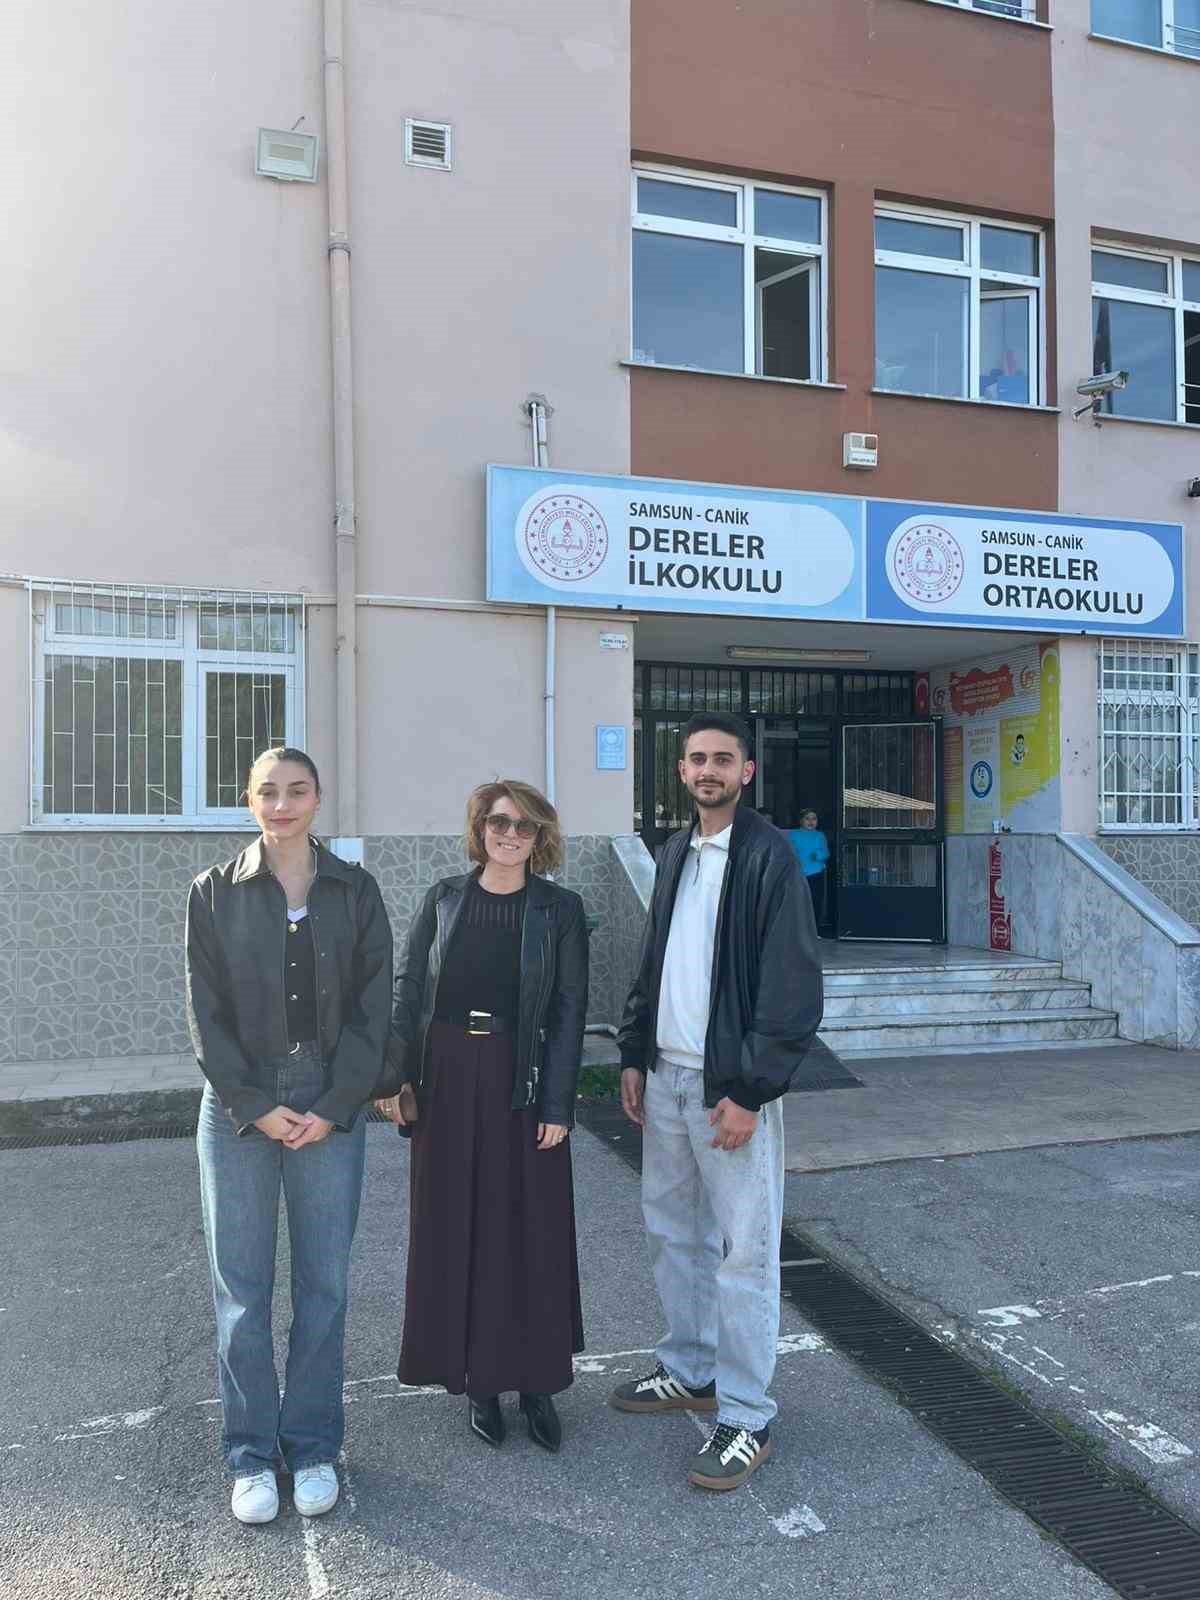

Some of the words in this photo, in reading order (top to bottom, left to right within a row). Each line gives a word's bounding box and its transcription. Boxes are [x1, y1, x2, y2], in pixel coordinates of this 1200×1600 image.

[629, 502, 693, 521] SAMSUN
[704, 506, 749, 526] CANİK
[629, 525, 765, 560] DERELER
[981, 529, 1036, 547] SAMSUN
[1045, 533, 1084, 551] CANİK
[628, 553, 782, 594] İLKOKULU
[983, 552, 1099, 582] DERELER
[983, 583, 1143, 615] ORTAOKULU
